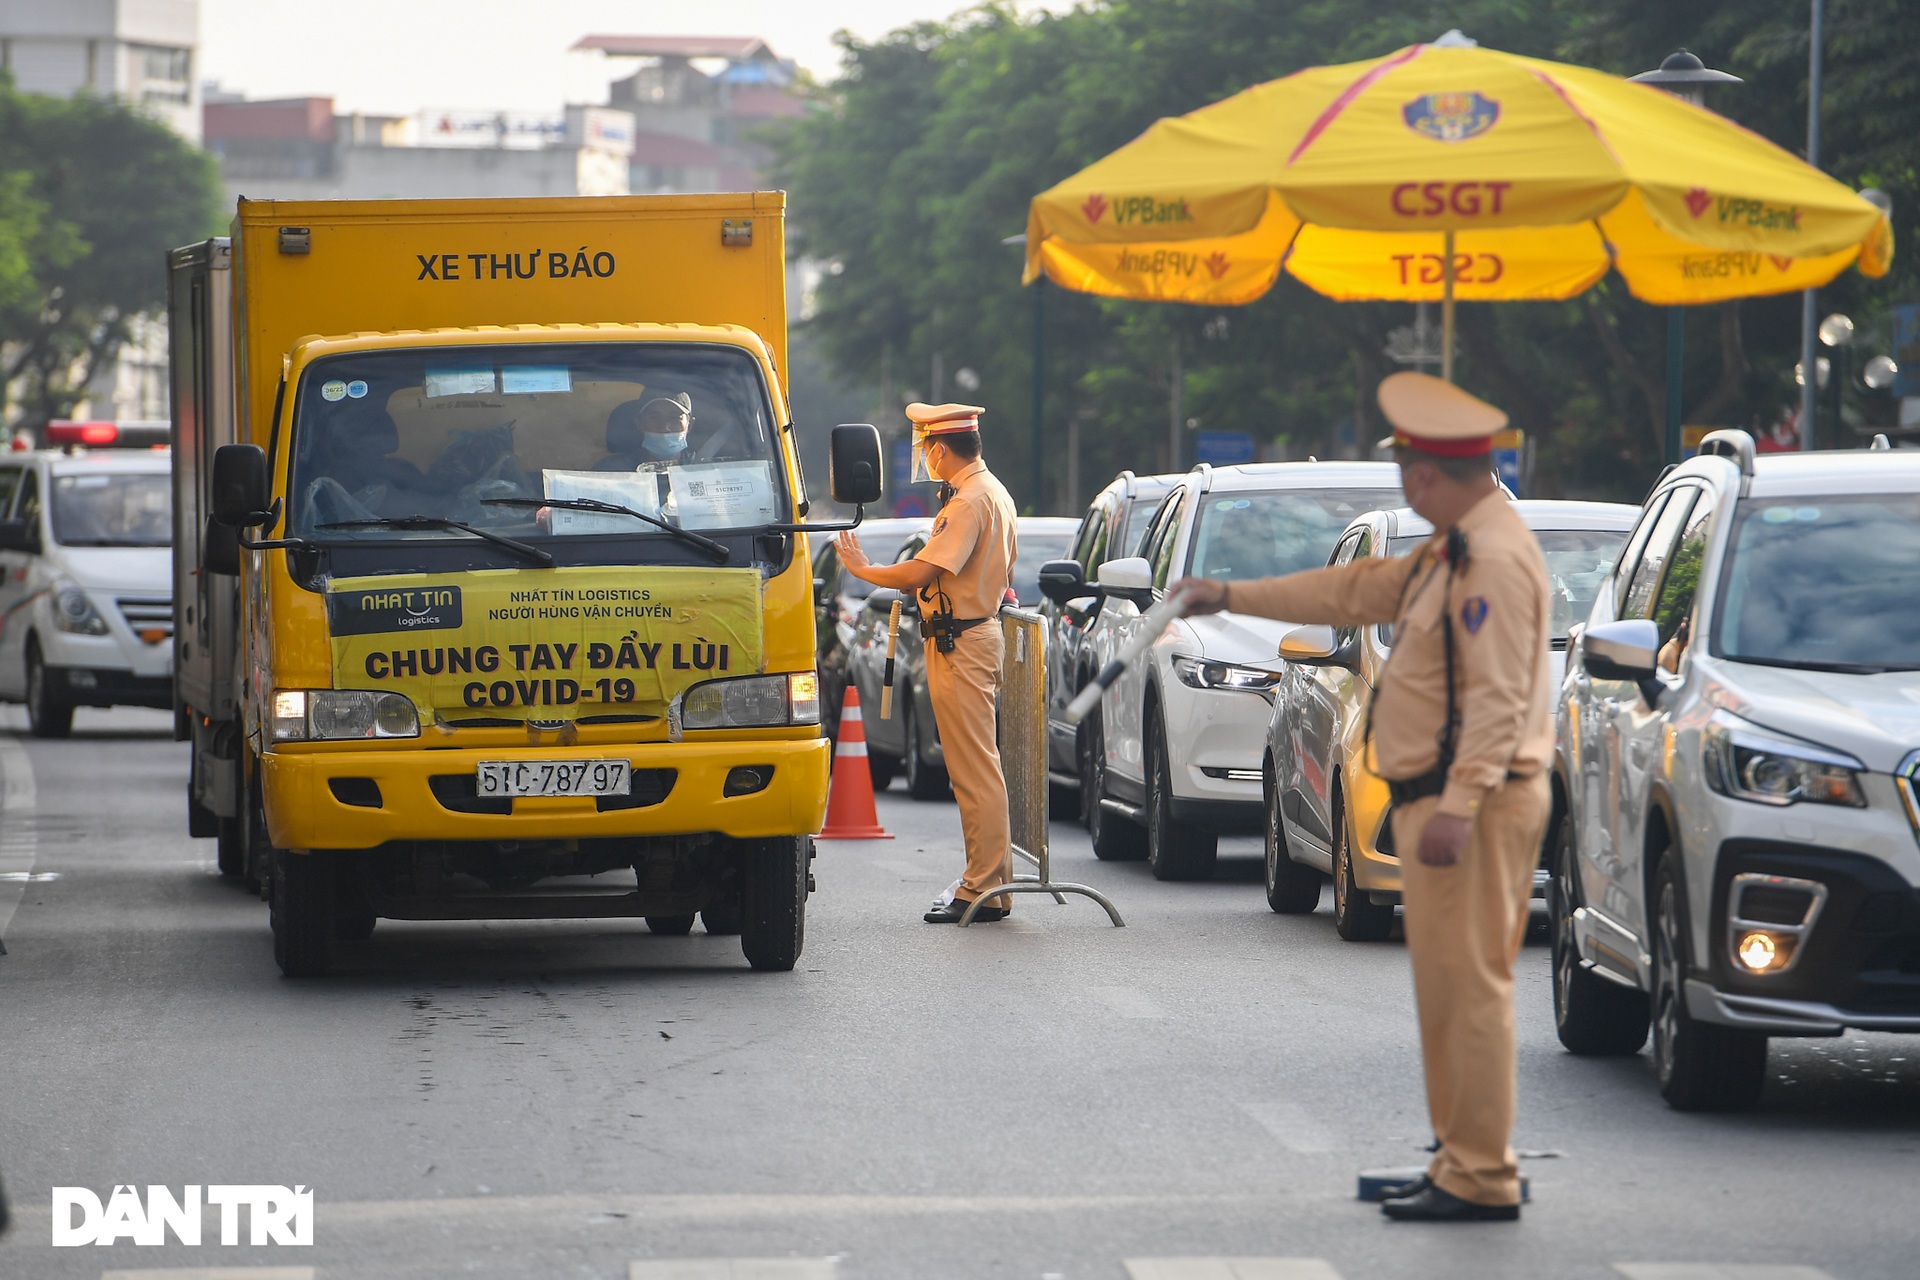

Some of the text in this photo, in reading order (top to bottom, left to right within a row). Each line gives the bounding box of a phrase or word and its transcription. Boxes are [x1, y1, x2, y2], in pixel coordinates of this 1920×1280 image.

[1112, 196, 1195, 224] VPBank
[1390, 181, 1512, 217] CSGT
[1716, 194, 1801, 232] VPBank
[416, 245, 616, 281] XE THƯ BÁO
[361, 590, 453, 611] NHAT TIN
[510, 587, 650, 602] NHẤT TÍN LOGISTICS
[397, 615, 440, 627] logistics
[489, 602, 672, 620] NGƯỜI HÙNG VẬN CHUYỂN
[364, 629, 729, 679] CHUNG TAY ĐẨY LÙI
[463, 677, 636, 708] COVID-19
